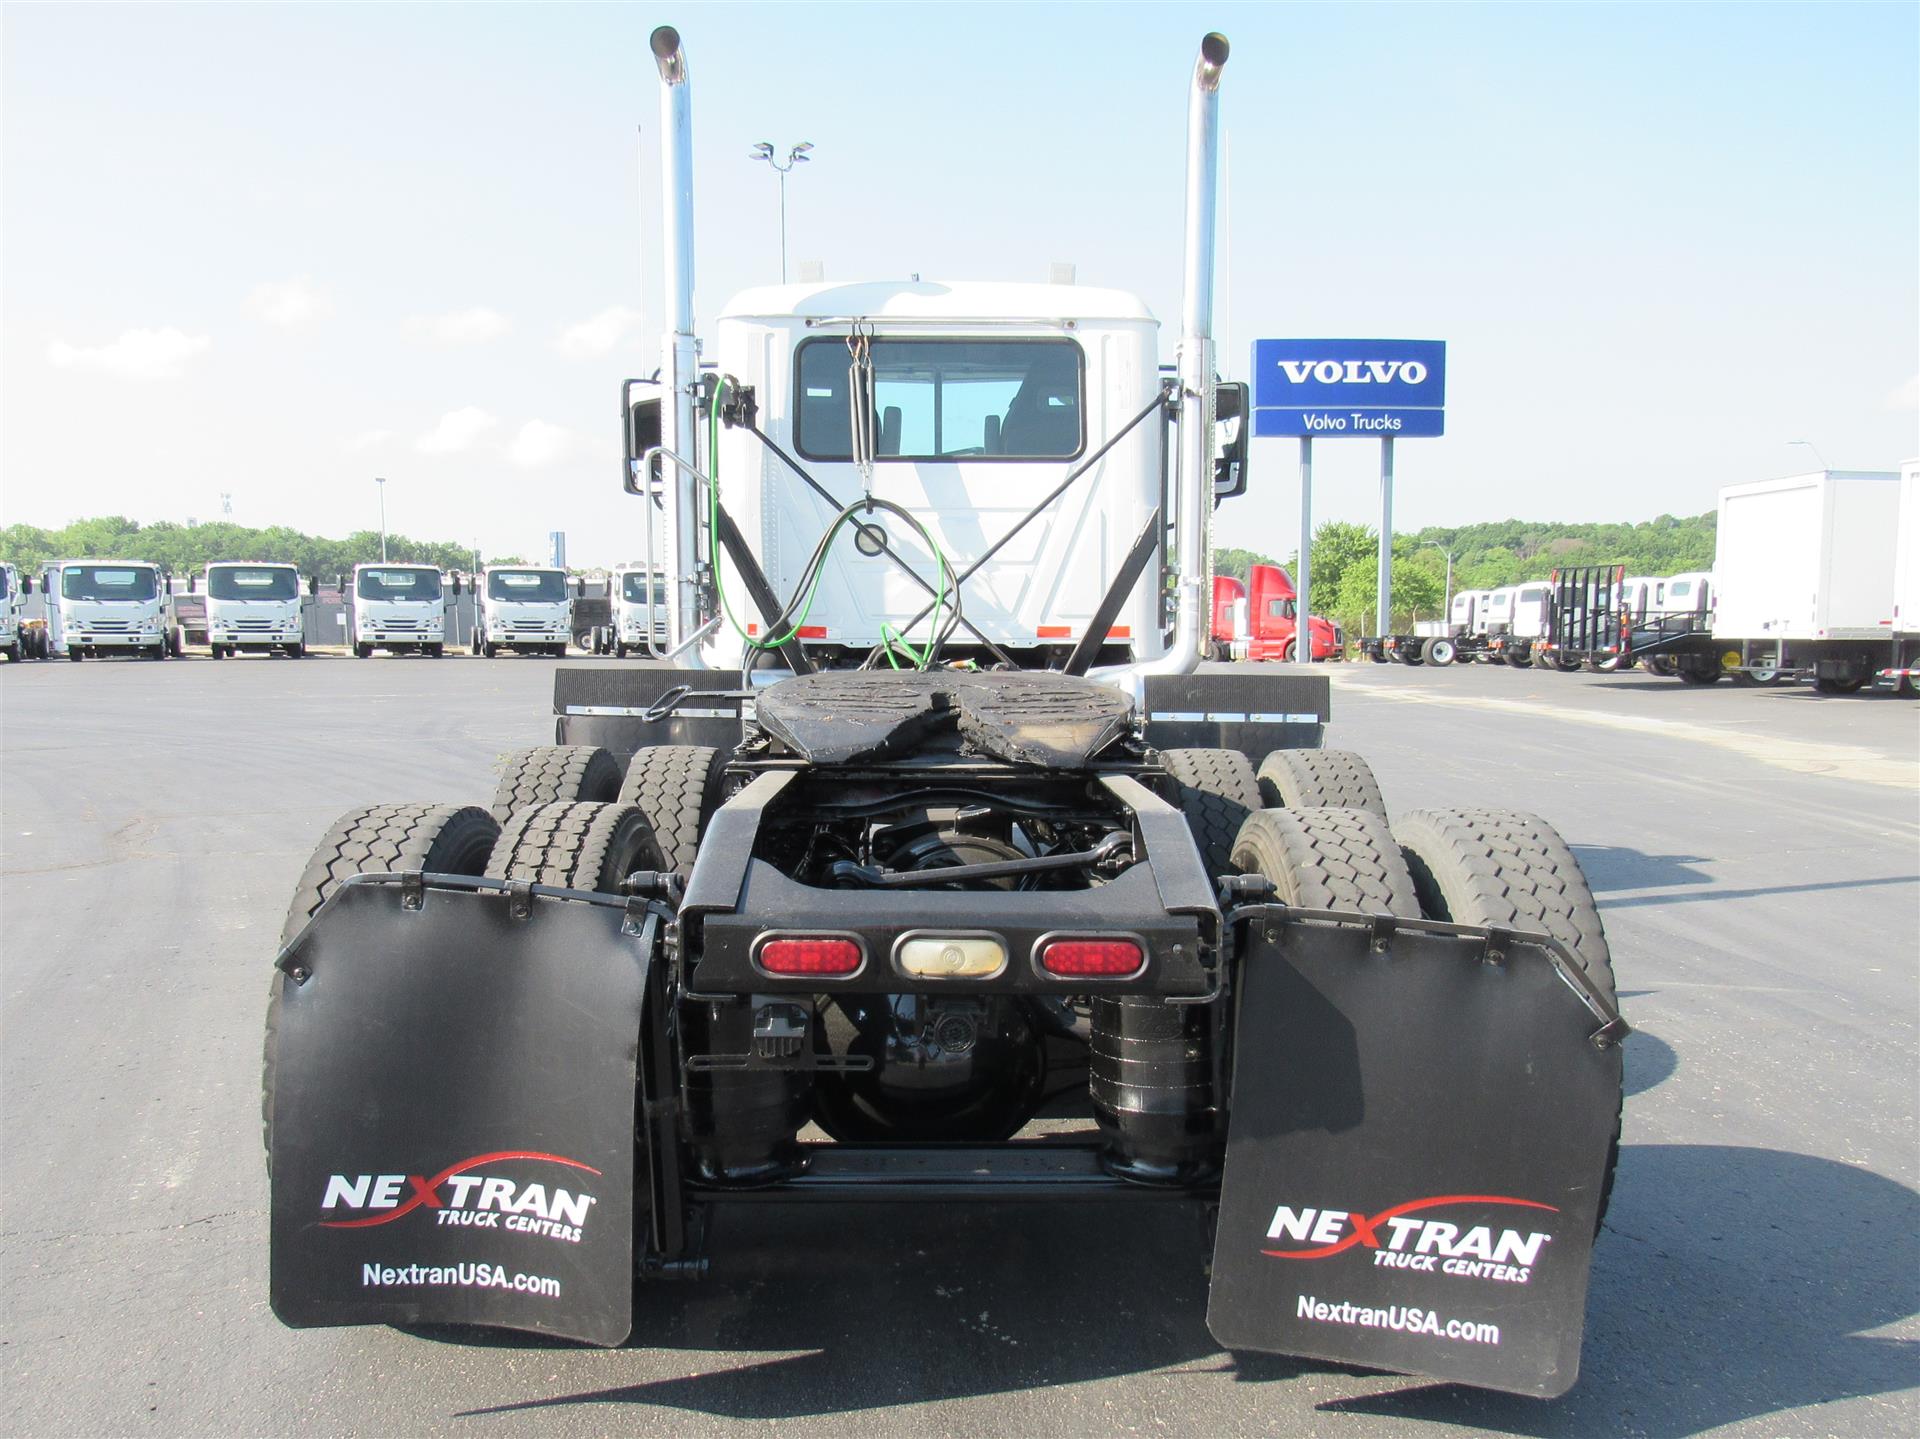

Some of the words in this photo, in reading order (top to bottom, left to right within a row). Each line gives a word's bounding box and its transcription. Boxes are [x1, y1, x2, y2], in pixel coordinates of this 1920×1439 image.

[1278, 361, 1427, 384] VOLVO
[1303, 414, 1346, 430] Volvo
[1351, 414, 1402, 430] Trucks
[322, 1174, 592, 1227] NEXTRAN
[437, 1210, 501, 1228] TRUCK
[505, 1214, 583, 1243] CENTERS
[1266, 1205, 1546, 1266] NEXTRAN
[363, 1263, 561, 1297] NextranUSA.com
[1373, 1250, 1438, 1272] TRUCK
[1442, 1258, 1530, 1283] CENTERS
[1297, 1295, 1499, 1345] NextranUSA.com
